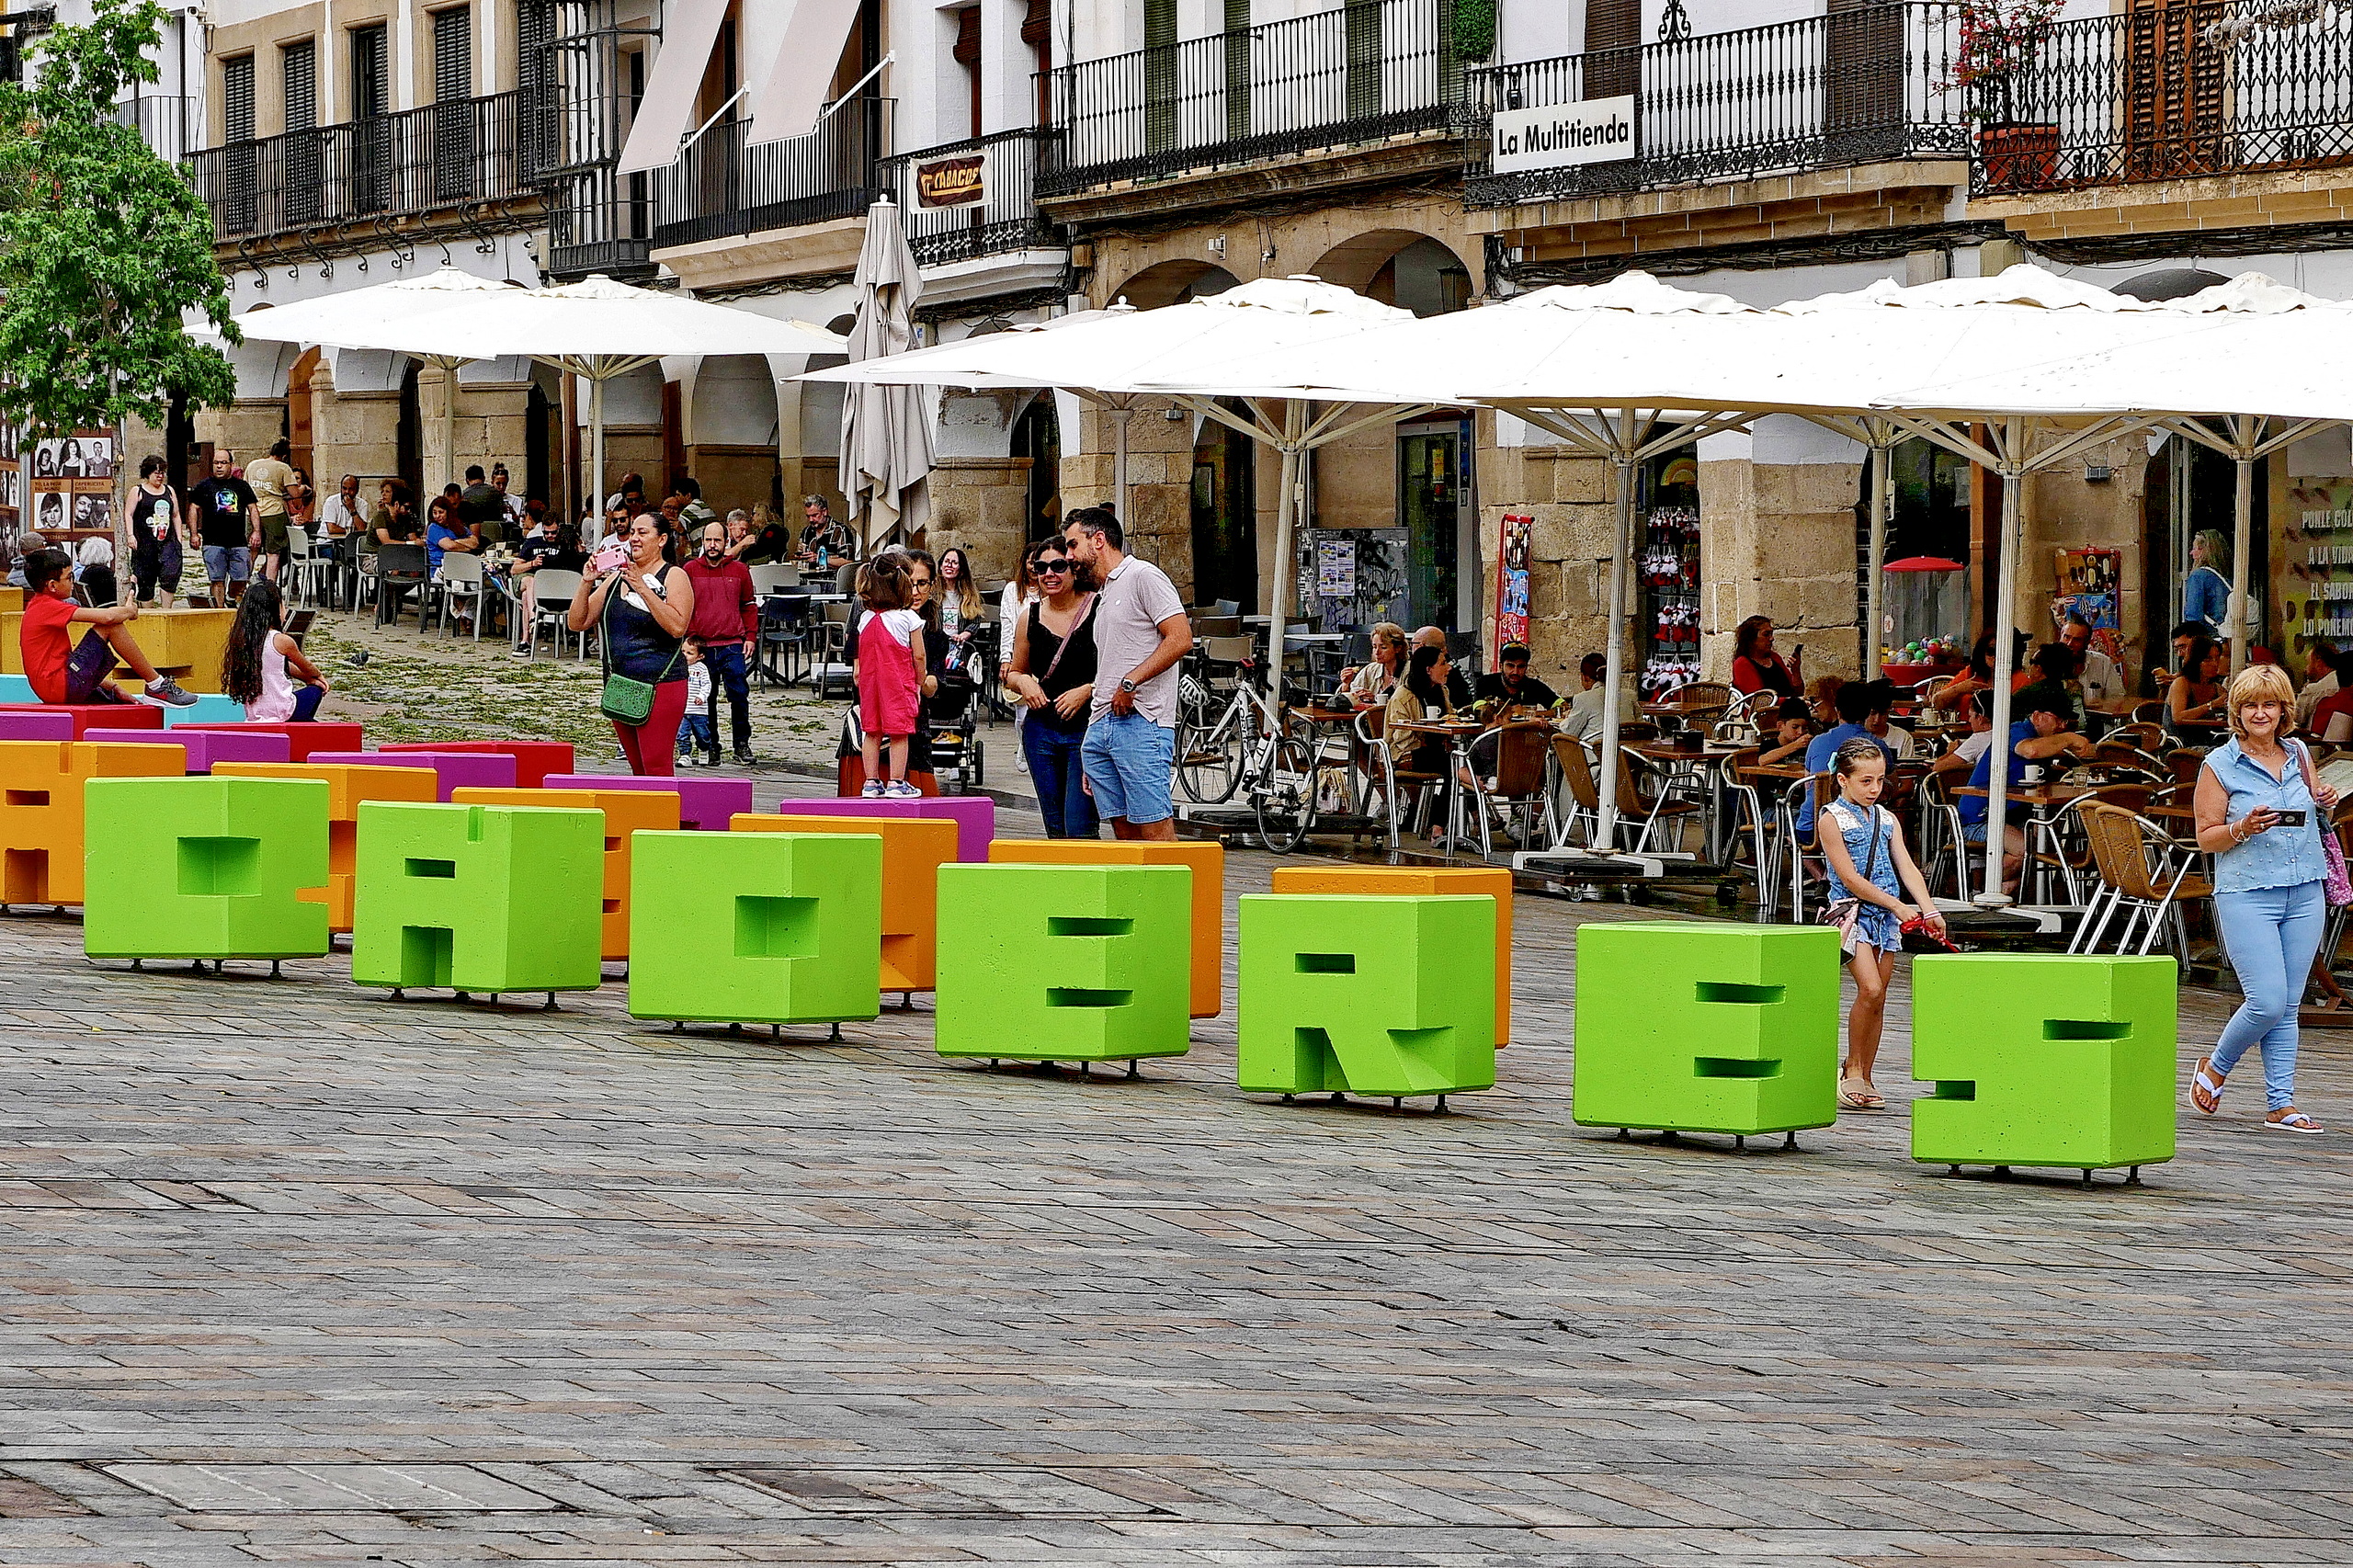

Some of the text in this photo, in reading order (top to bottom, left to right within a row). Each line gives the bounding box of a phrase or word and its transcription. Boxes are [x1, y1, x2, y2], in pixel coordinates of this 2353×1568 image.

[1498, 113, 1629, 156] La Multitienda
[2302, 510, 2331, 528] PONLE
[2308, 546, 2315, 564] A
[2318, 546, 2329, 564] LA
[2310, 583, 2320, 601] EL
[2302, 619, 2314, 636] LO
